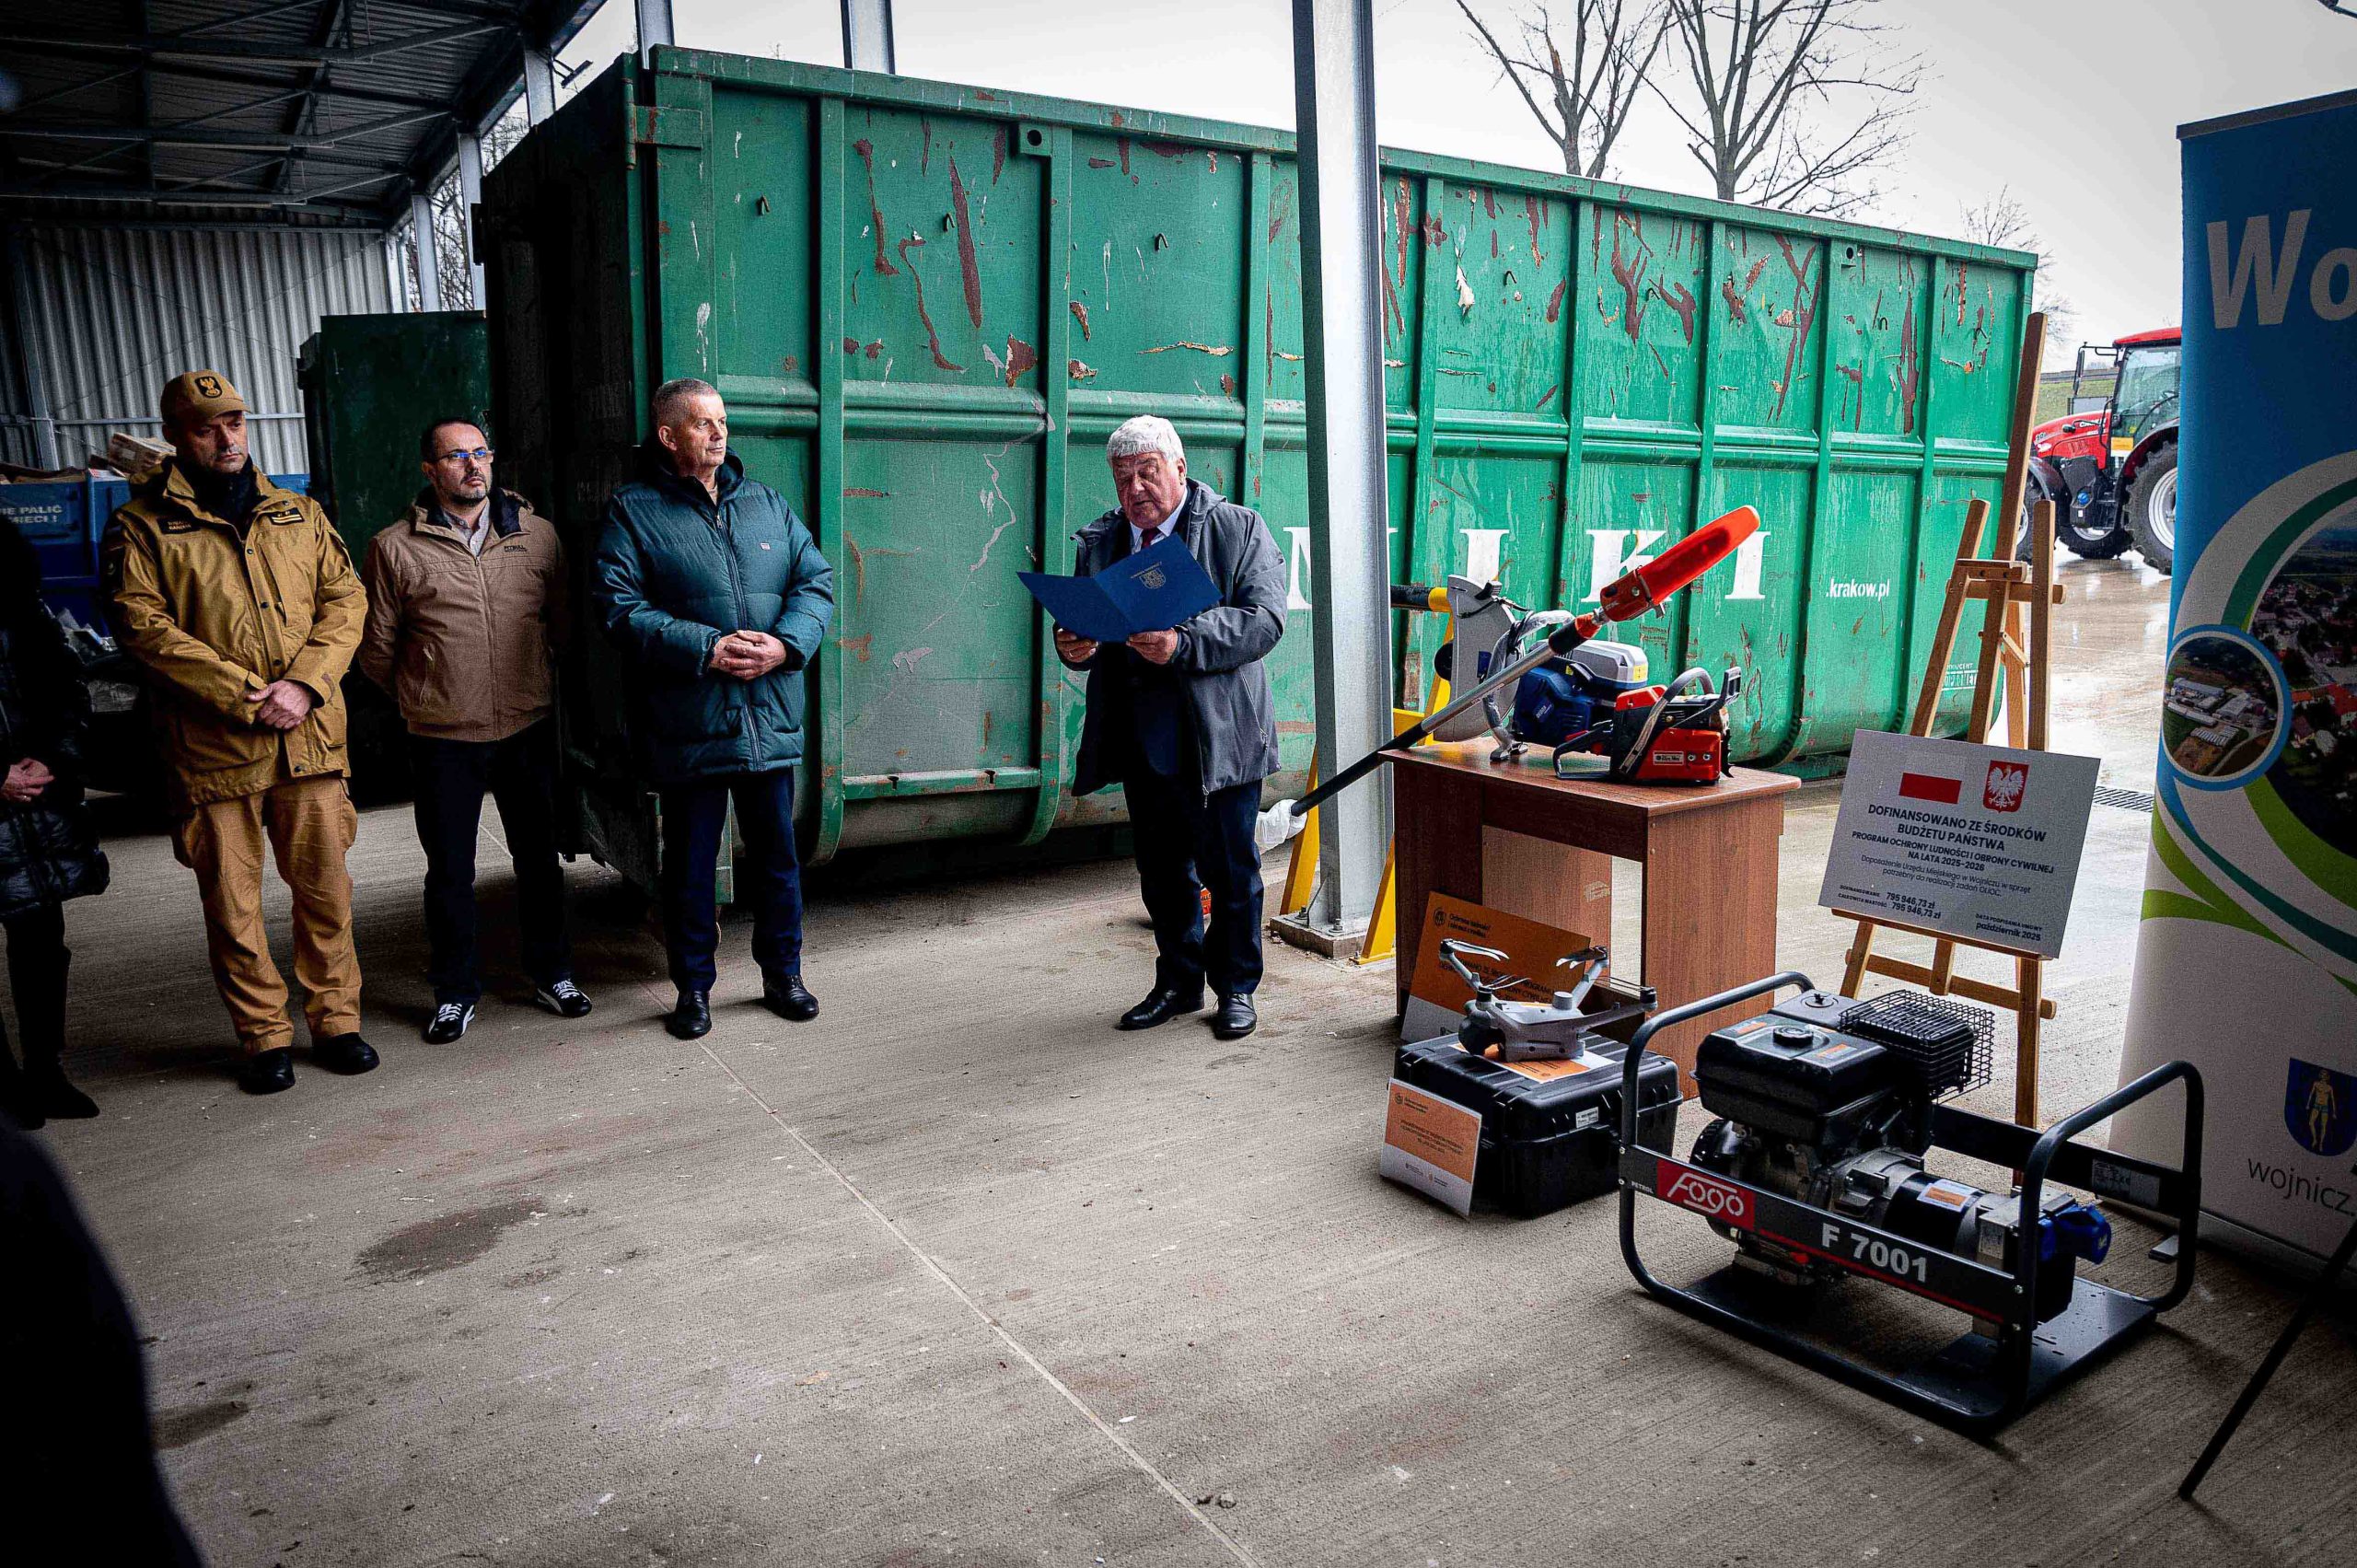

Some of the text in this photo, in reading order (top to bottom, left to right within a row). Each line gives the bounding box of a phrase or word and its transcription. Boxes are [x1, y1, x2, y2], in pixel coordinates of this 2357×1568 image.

[0, 505, 64, 516] IE PALIĆ
[1825, 578, 1890, 602] .krakow.pl
[1868, 804, 2047, 842] DOFINANSOWANO ZE ŚRODKÓW
[1897, 823, 2004, 851] BUDŻETU PAŃSTWA
[1852, 830, 1889, 844] PROGRAM
[1889, 838, 1928, 851] OCHRONY
[1929, 845, 1968, 858] LUDNOŚCI
[1974, 853, 2010, 866] OBRONY
[2011, 859, 2054, 874] CYWILNEJ
[1908, 851, 1920, 860] NA
[1921, 853, 1940, 864] LATA
[1882, 868, 1915, 880] potrzebny
[1915, 873, 1925, 881] do
[1902, 863, 1925, 873] Urzędu
[1886, 891, 1900, 901] 795
[1901, 895, 1927, 907] 946,73
[1928, 900, 1935, 909] zł
[1891, 901, 1906, 912] 795
[1907, 905, 1933, 917] 946,73
[1933, 911, 1941, 919] zł
[1975, 922, 2041, 941] październik 2025
[1822, 1222, 1927, 1283] F 7001
